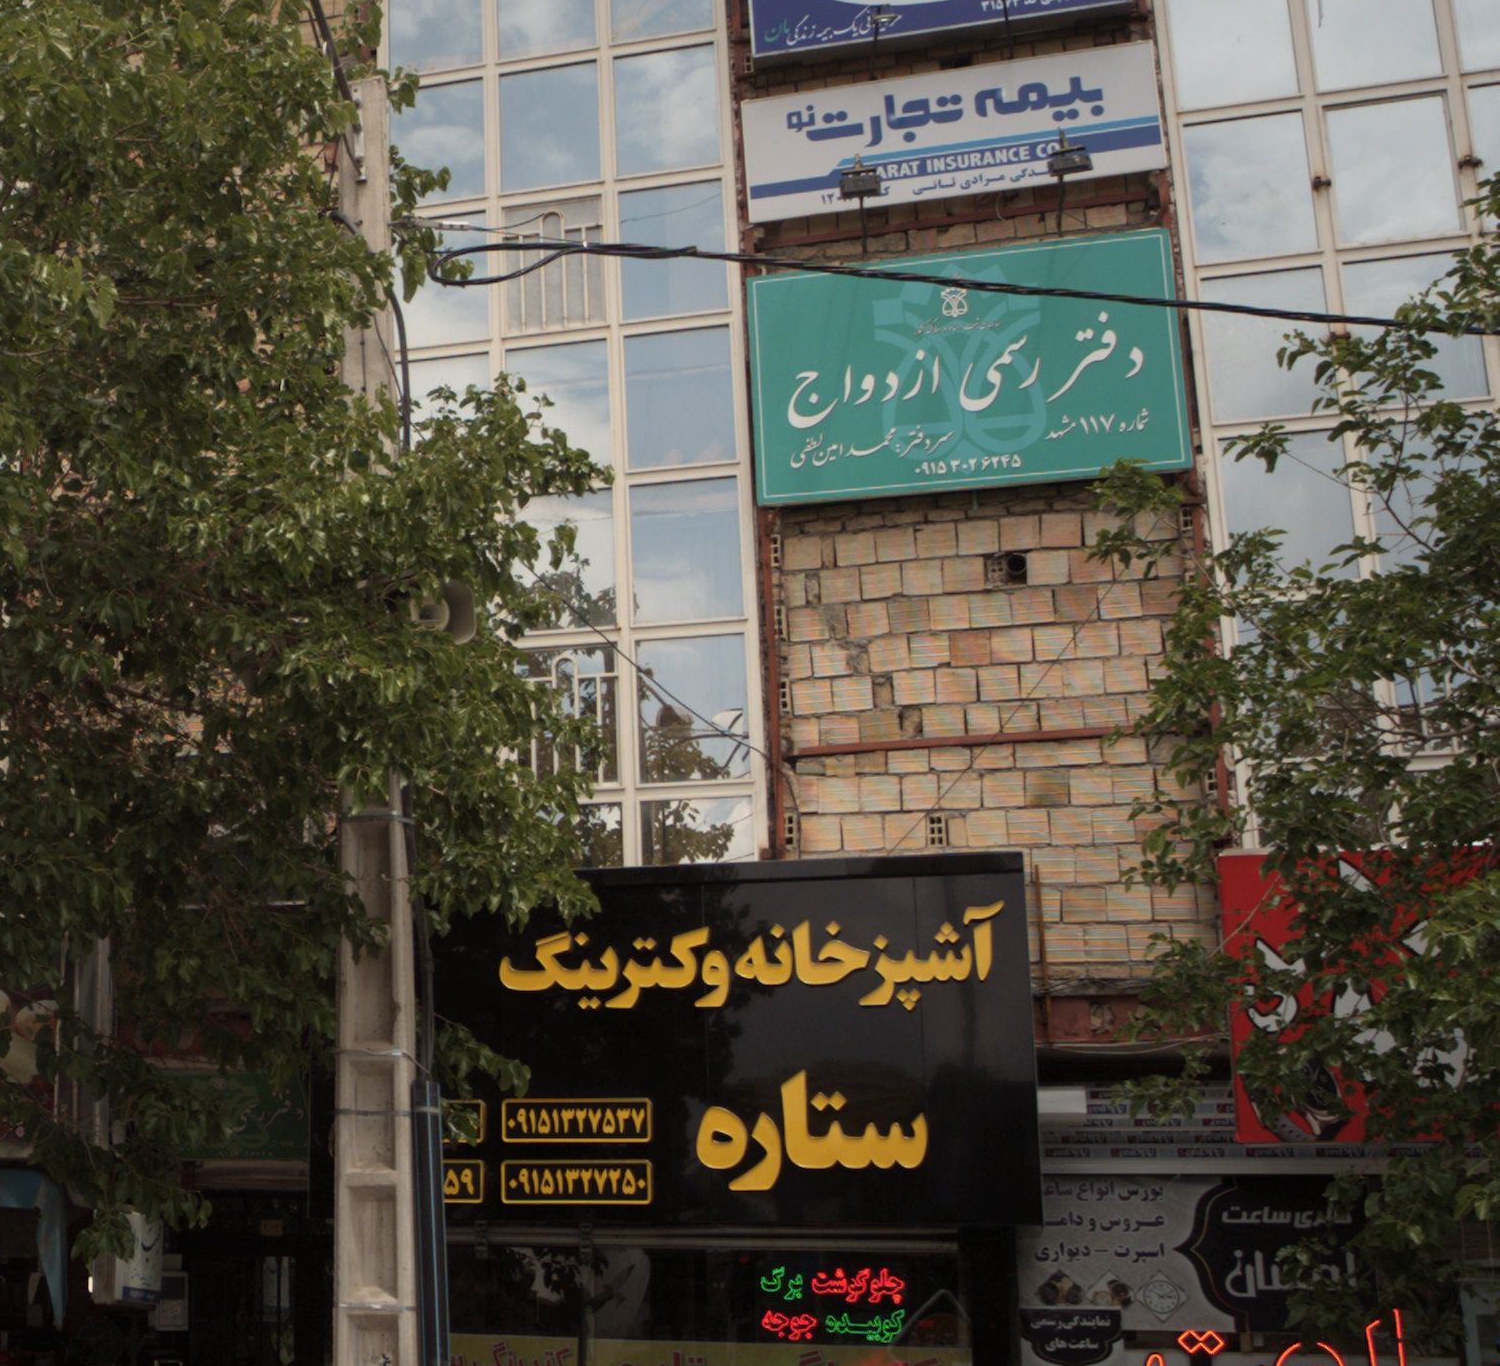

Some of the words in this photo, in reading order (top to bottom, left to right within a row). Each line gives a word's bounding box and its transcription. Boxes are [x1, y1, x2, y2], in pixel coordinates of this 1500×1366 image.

[973, 75, 1105, 122] بیمه
[786, 104, 816, 133] نو
[805, 93, 964, 148] تجارت
[925, 145, 1031, 174] INSURANCE
[959, 173, 1006, 190] مرادی
[1046, 311, 1144, 403] دفتر
[959, 334, 1041, 412] رسمی
[787, 349, 941, 429] ازدواج
[1044, 414, 1077, 441] مشهد
[1079, 413, 1116, 435] ۱۱۷
[1118, 407, 1150, 433] شماره
[789, 432, 825, 469] لطفی
[811, 443, 844, 467] امین
[845, 427, 897, 457] محمد
[915, 461, 947, 475] ۰۹۱۵
[734, 899, 1006, 1012] آشپزخانه
[506, 1104, 646, 1135] ۰۹۱۵۱۳۲۷۵۳۷
[696, 1068, 929, 1192] ستاره
[507, 1166, 647, 1196] ۰۹۱۵۱۳۲۷۲۵۰
[1043, 1182, 1073, 1196] ساع
[1076, 1179, 1115, 1202] انواع
[1044, 1212, 1084, 1227] دام
[1087, 1216, 1097, 1233] و
[1099, 1214, 1165, 1232] عروس
[1221, 1205, 1292, 1225] ساعت
[1034, 1241, 1091, 1263] دیواری
[1113, 1242, 1165, 1264] اسپرت
[760, 1265, 804, 1301] برگ
[761, 1310, 818, 1341] جوجه
[824, 1308, 906, 1344] کوبیده
